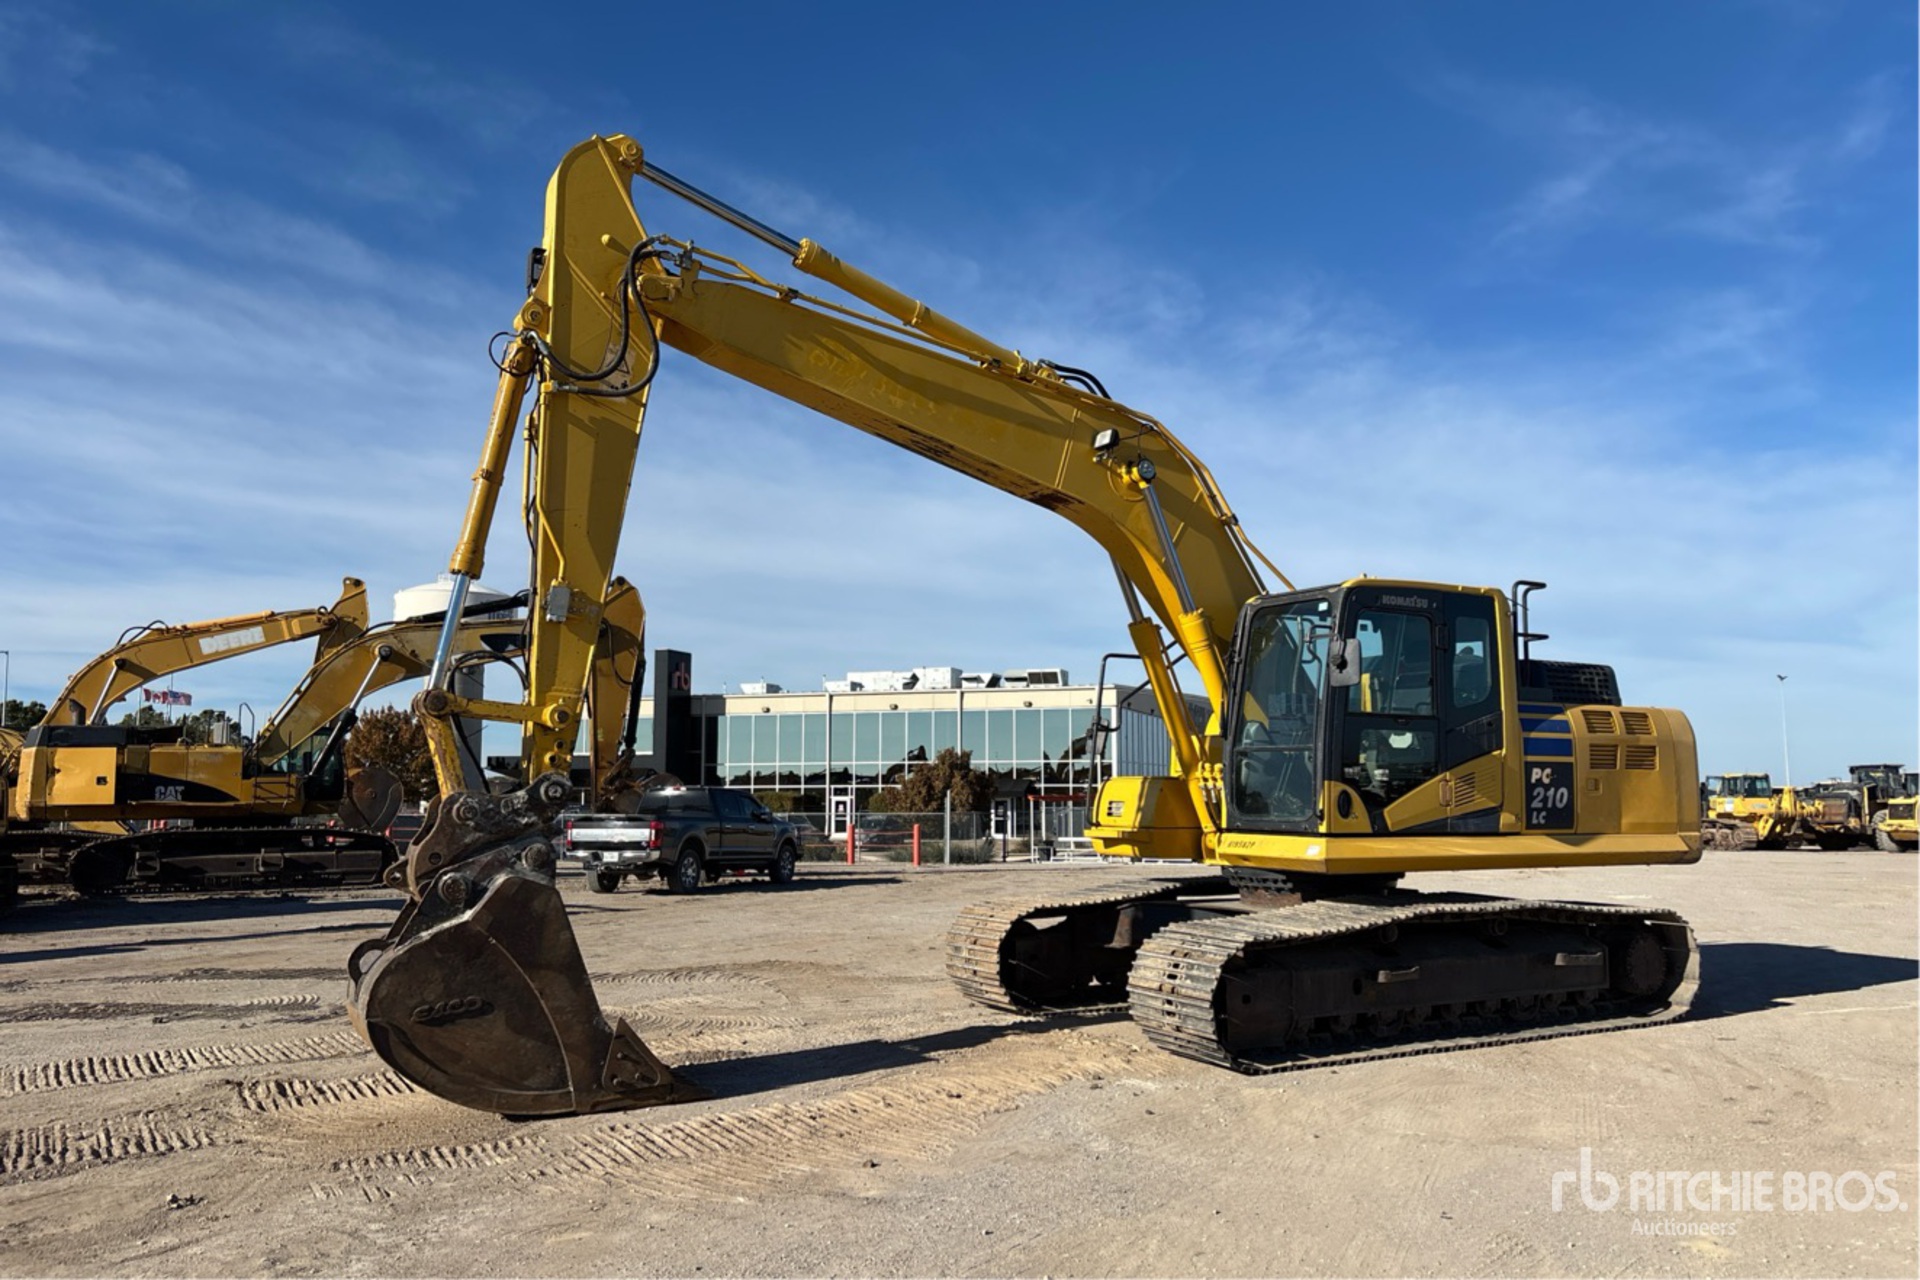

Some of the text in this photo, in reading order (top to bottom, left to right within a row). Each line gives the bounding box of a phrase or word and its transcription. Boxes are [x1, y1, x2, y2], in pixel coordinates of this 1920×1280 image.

[1382, 595, 1428, 608] KOMATSU
[199, 626, 265, 655] DEERE
[671, 662, 690, 690] rb
[1531, 767, 1552, 784] PC
[155, 786, 185, 801] CAT
[1531, 787, 1568, 809] 210
[1532, 811, 1546, 824] LC
